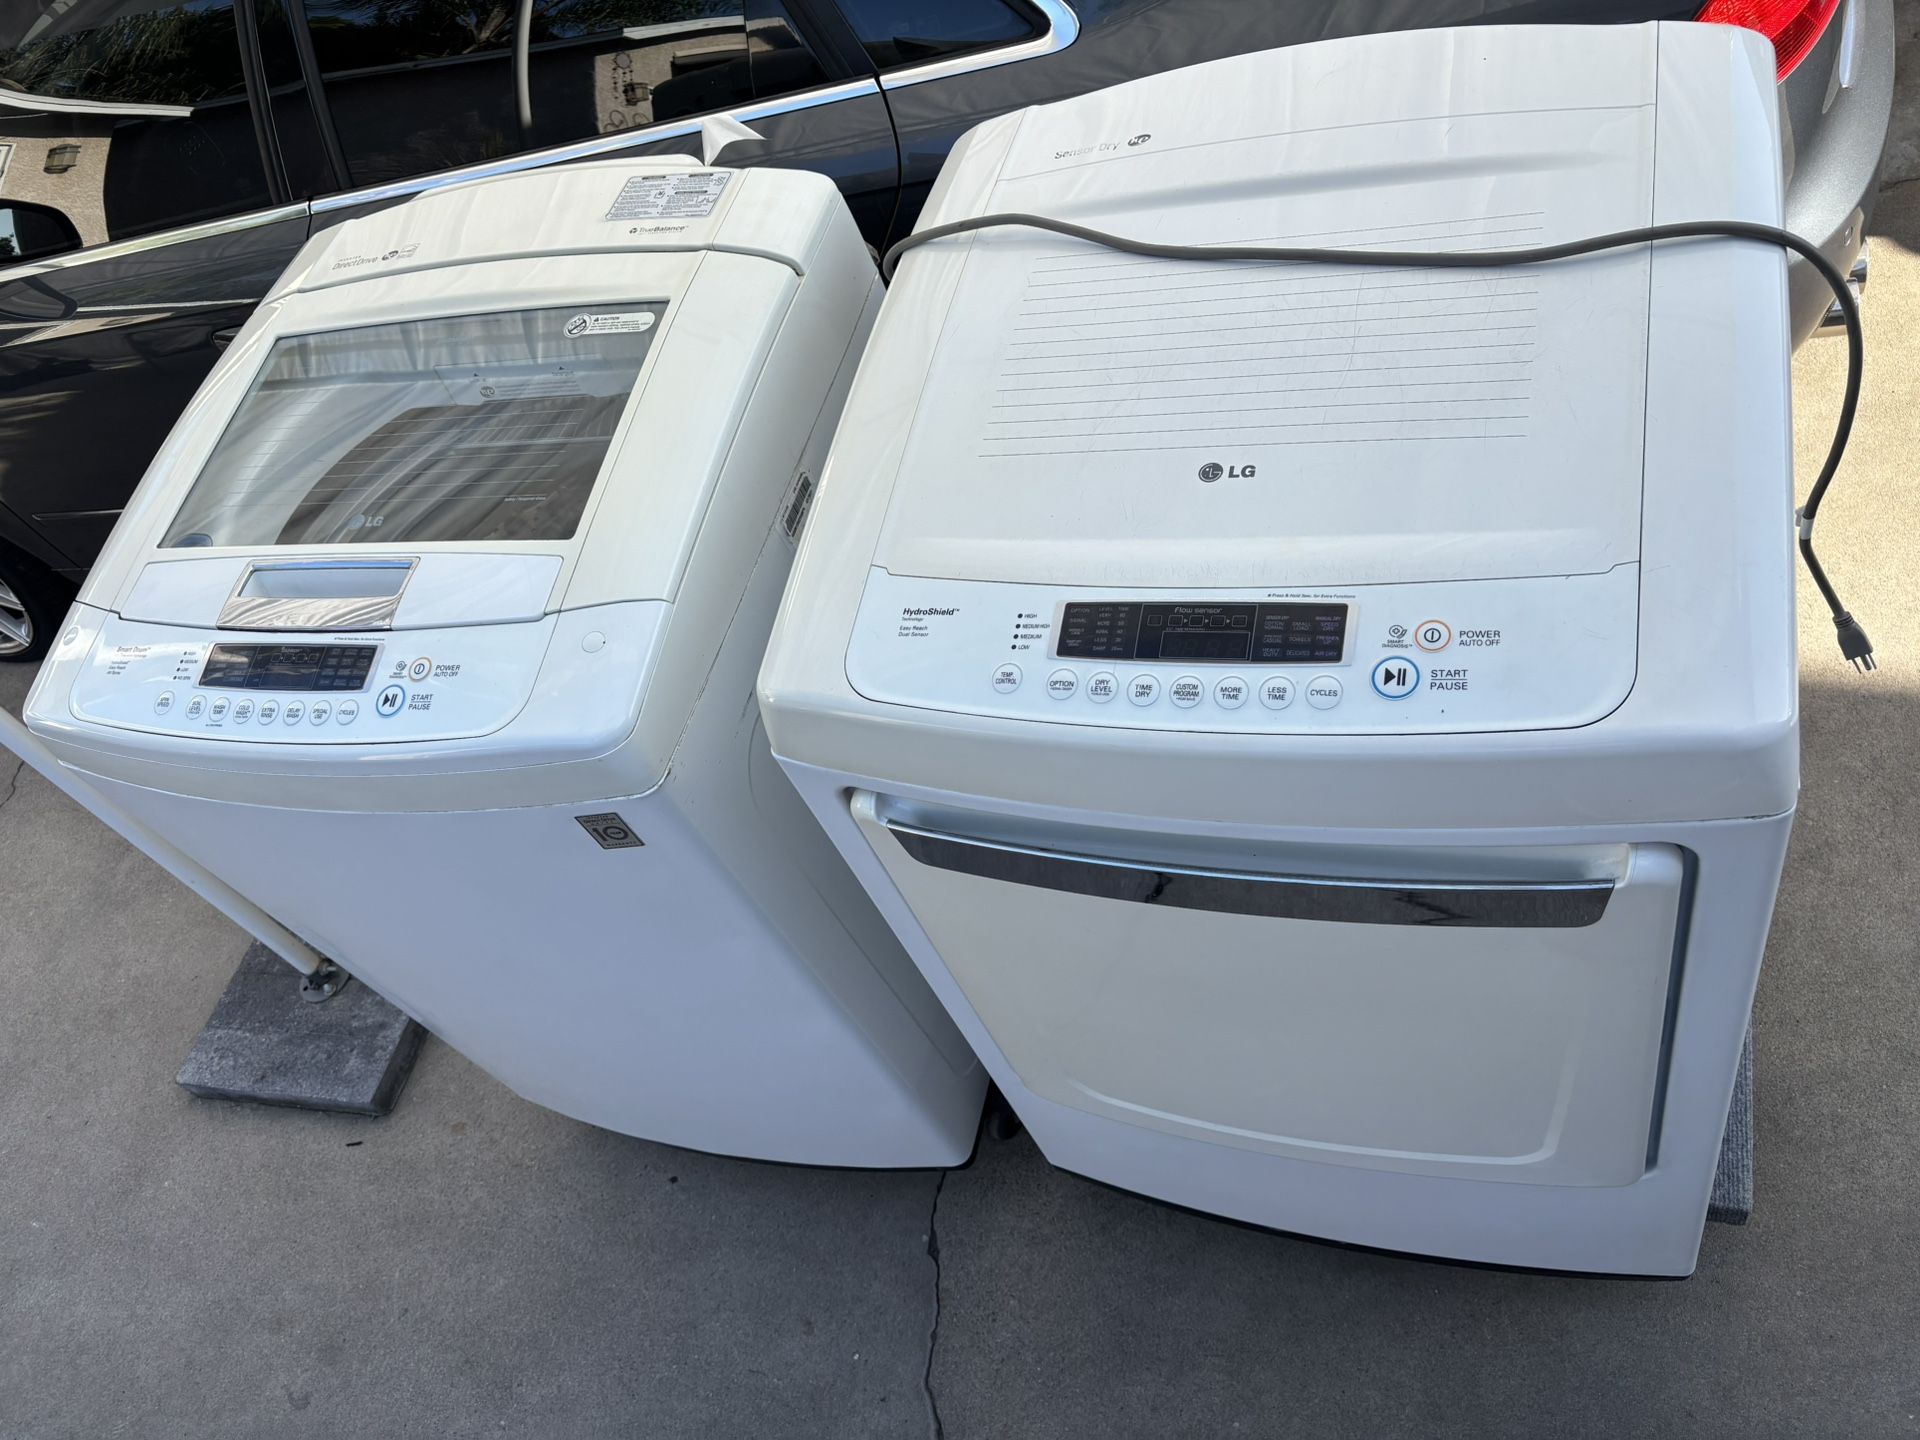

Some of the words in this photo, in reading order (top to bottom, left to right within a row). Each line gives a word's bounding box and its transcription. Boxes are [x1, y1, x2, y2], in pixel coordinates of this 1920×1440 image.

[1054, 144, 1097, 160] Sensor
[1098, 141, 1120, 151] Dry
[1228, 464, 1257, 478] LG
[365, 516, 384, 527] LG
[1459, 630, 1501, 638] POWER
[1430, 669, 1469, 678] START
[1049, 680, 1074, 688] OPTION
[1430, 682, 1468, 691] PAUSE
[1134, 690, 1152, 698] DRY
[1173, 690, 1200, 698] PROGRAM
[1220, 686, 1242, 694] MORE
[1268, 686, 1288, 694] LESS
